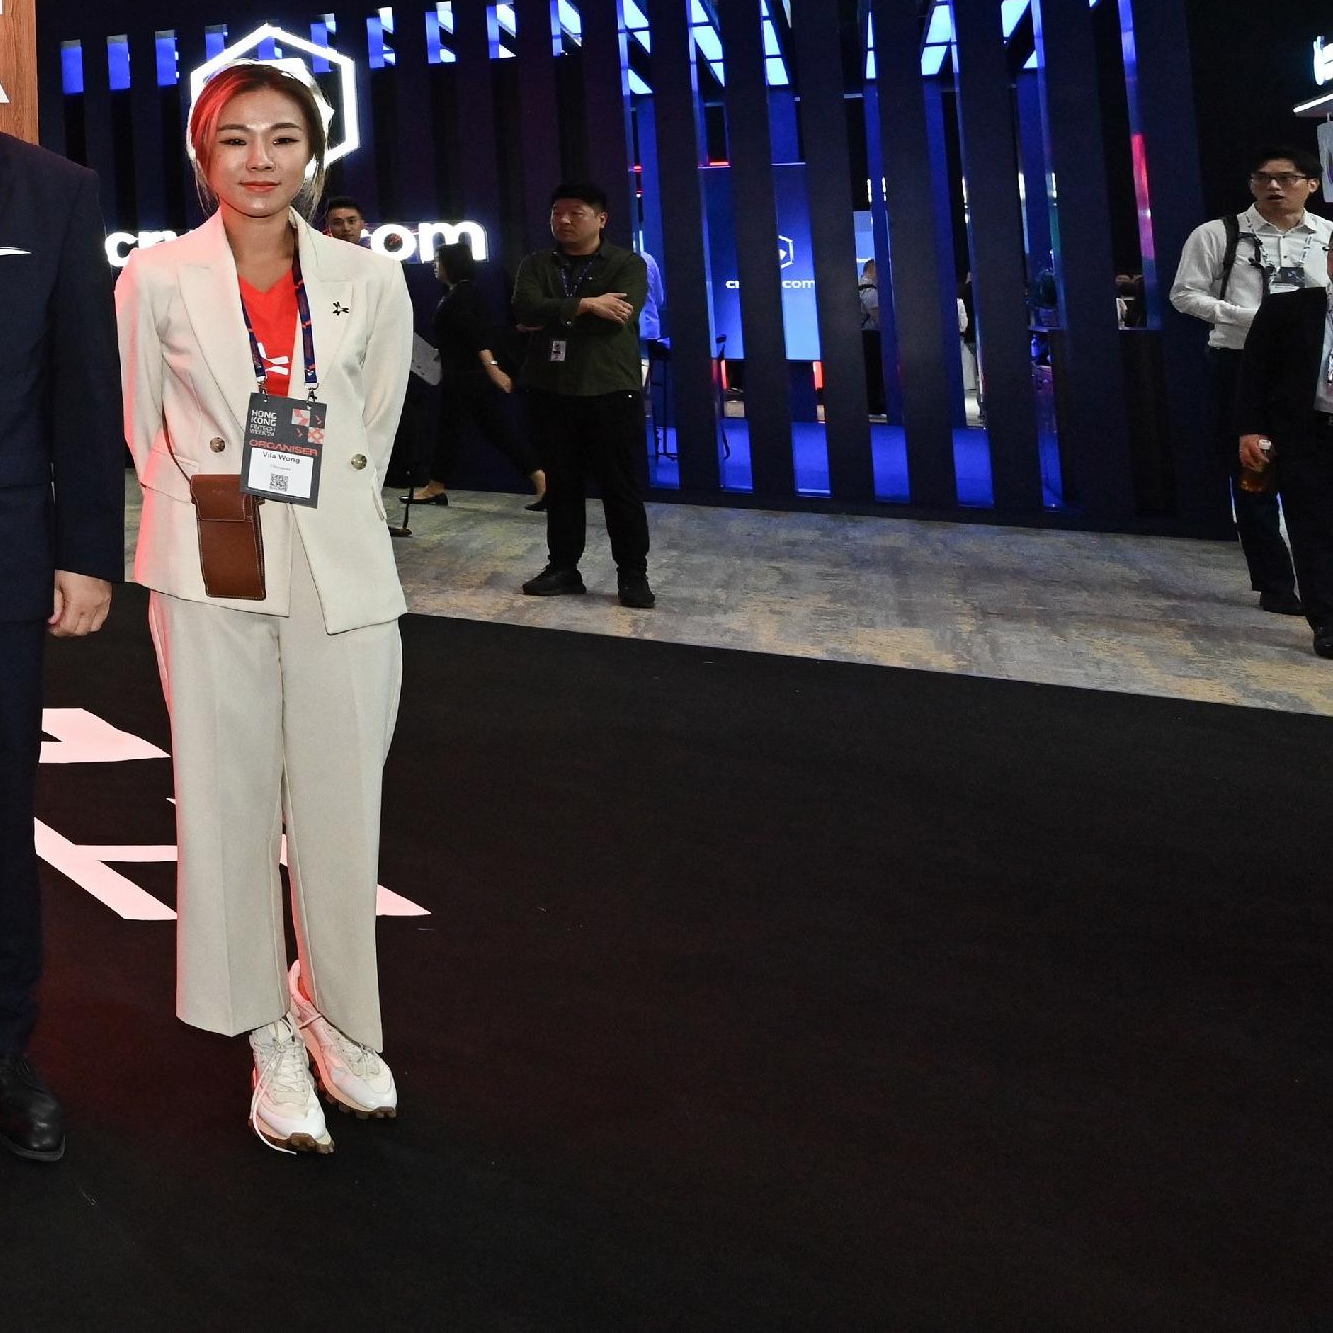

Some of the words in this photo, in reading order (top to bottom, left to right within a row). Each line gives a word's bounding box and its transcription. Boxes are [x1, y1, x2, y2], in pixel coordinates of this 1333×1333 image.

[251, 409, 277, 420] HONG
[250, 417, 277, 427] KONG
[248, 439, 318, 457] ORGANISER
